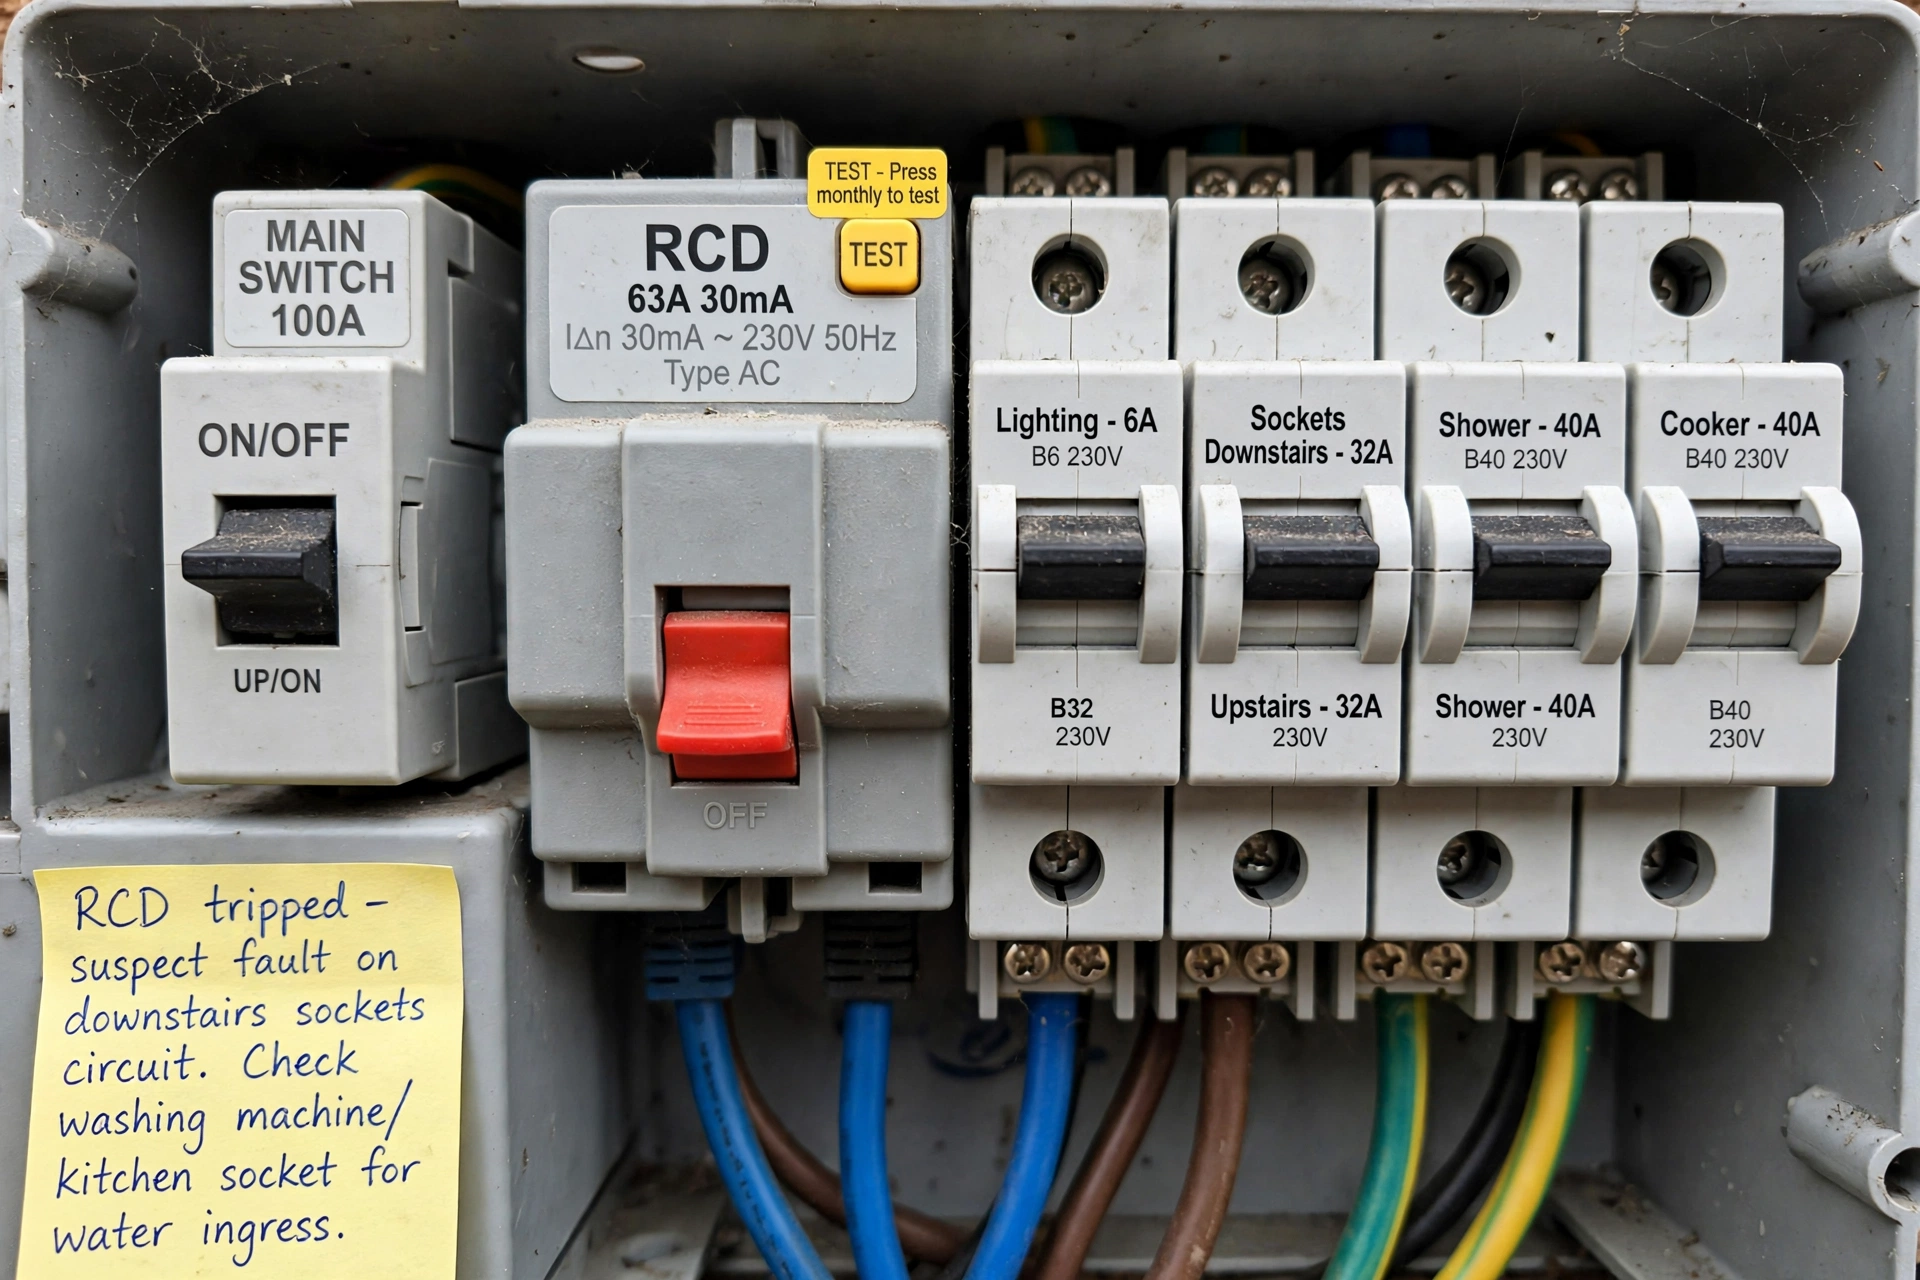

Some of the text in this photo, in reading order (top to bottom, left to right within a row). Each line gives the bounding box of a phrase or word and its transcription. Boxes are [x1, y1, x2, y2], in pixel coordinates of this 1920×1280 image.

[824, 161, 872, 181] TEST
[889, 161, 937, 181] Press
[816, 184, 940, 208] monthly to test
[267, 219, 365, 253] MAIN
[645, 223, 769, 273] RCD
[848, 241, 908, 268] TEST
[238, 259, 394, 295] SWITCH
[627, 283, 794, 314] 63A 30mA
[271, 303, 366, 337] 100A
[621, 322, 705, 351] 30mA
[742, 323, 816, 352] 230V
[824, 323, 897, 352] 50Hz
[663, 358, 781, 393] Type AC
[996, 406, 1099, 440] Lighting
[1123, 406, 1158, 433] 6A
[1250, 404, 1346, 432] Sockets
[1438, 411, 1532, 438] Shower
[1553, 412, 1602, 438] 40A
[1660, 409, 1751, 437] Cooker
[1772, 410, 1821, 437] 40A
[198, 422, 350, 458] ON/OFF
[1205, 438, 1329, 465] Downstairs
[1350, 438, 1394, 465] 32A
[1032, 445, 1124, 467] B6 230V
[1465, 448, 1568, 470] B40 230V
[1686, 447, 1790, 470] B40 230V
[233, 667, 321, 694] UP/ON
[1051, 697, 1094, 719] B32
[1211, 693, 1312, 725] Upstairs
[1335, 693, 1383, 719] 32A
[1435, 693, 1527, 719] Shower
[1548, 693, 1596, 719] 40A
[1709, 699, 1751, 721] B40
[1055, 726, 1112, 747] 230V
[1272, 726, 1328, 748] 230V
[1492, 727, 1548, 748] 230V
[1709, 728, 1765, 749] 230V
[703, 801, 768, 830] OFF
[74, 885, 169, 931] RCD
[203, 880, 349, 939] tripped
[70, 936, 399, 996] suspect fault on
[64, 986, 425, 1035] downstairs sockets
[63, 1039, 359, 1086] circuit. Check
[59, 1078, 414, 1156] washing machine/
[56, 1144, 421, 1199] kitchen socket for
[53, 1208, 344, 1268] water ingress.
